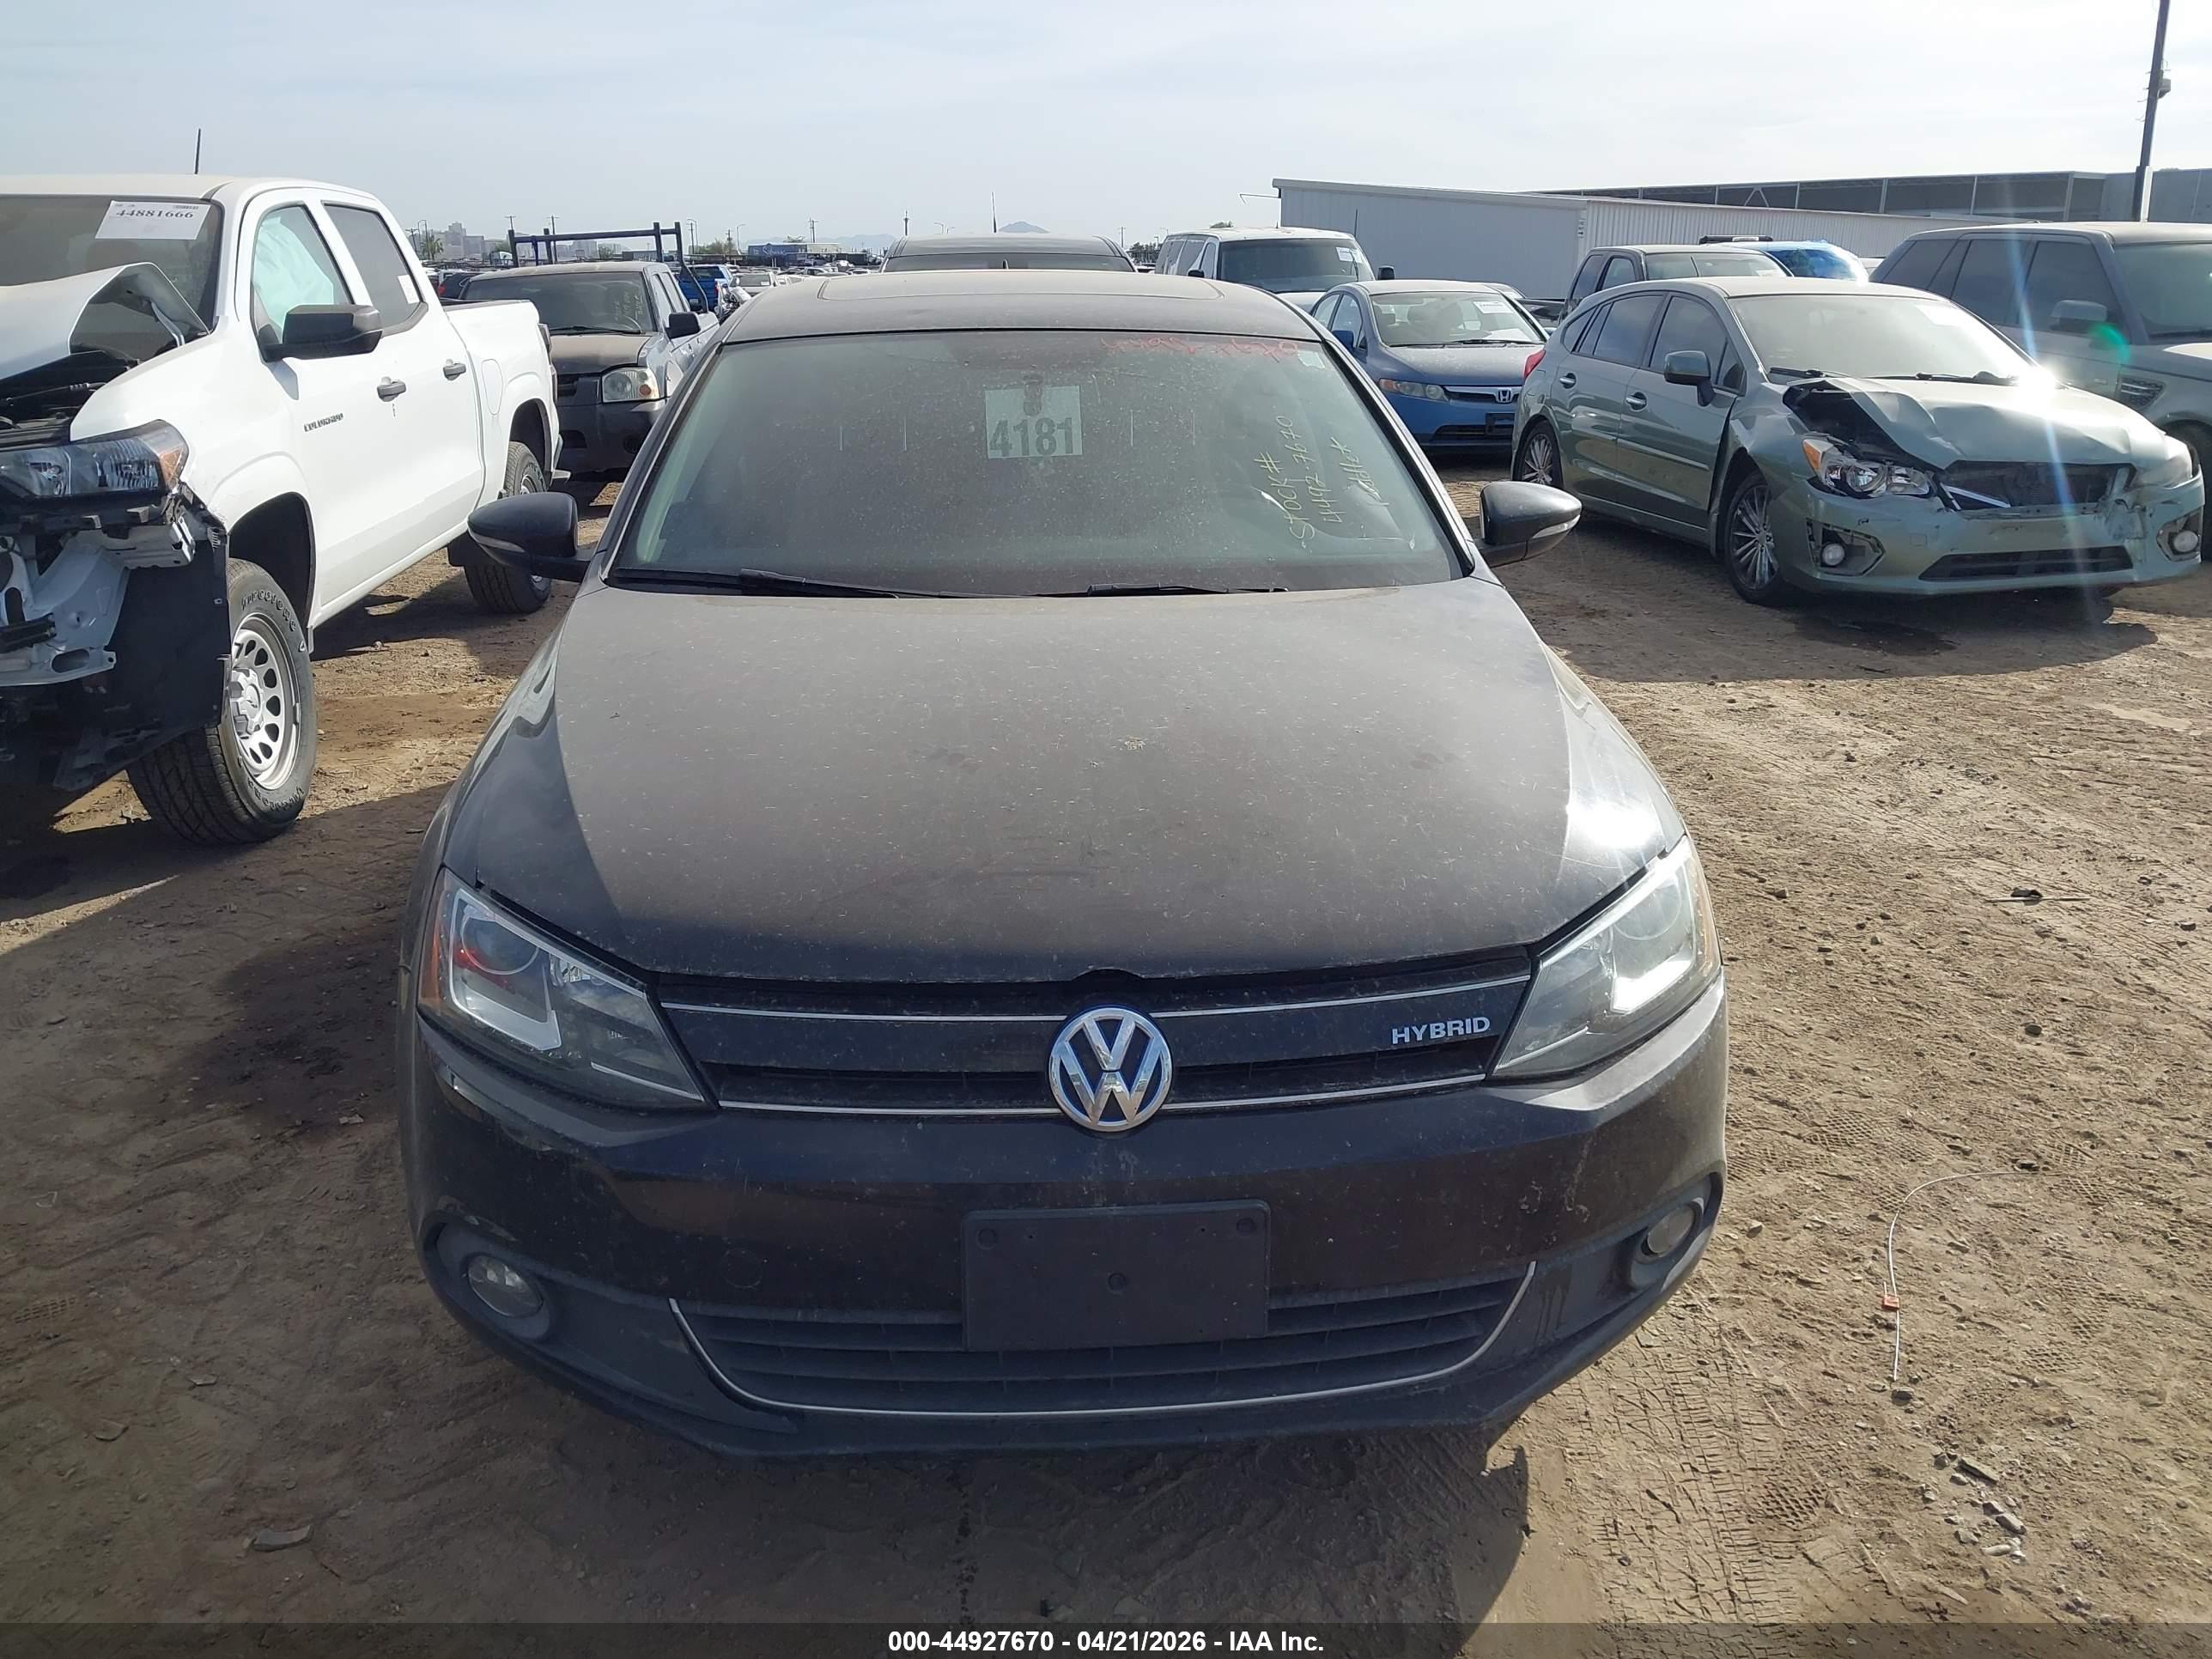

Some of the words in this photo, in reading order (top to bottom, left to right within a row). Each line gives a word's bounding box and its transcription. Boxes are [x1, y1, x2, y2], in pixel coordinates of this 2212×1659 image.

[116, 209, 194, 218] 44881666
[988, 416, 1073, 457] 4181
[1392, 1016, 1491, 1044] HYBRID
